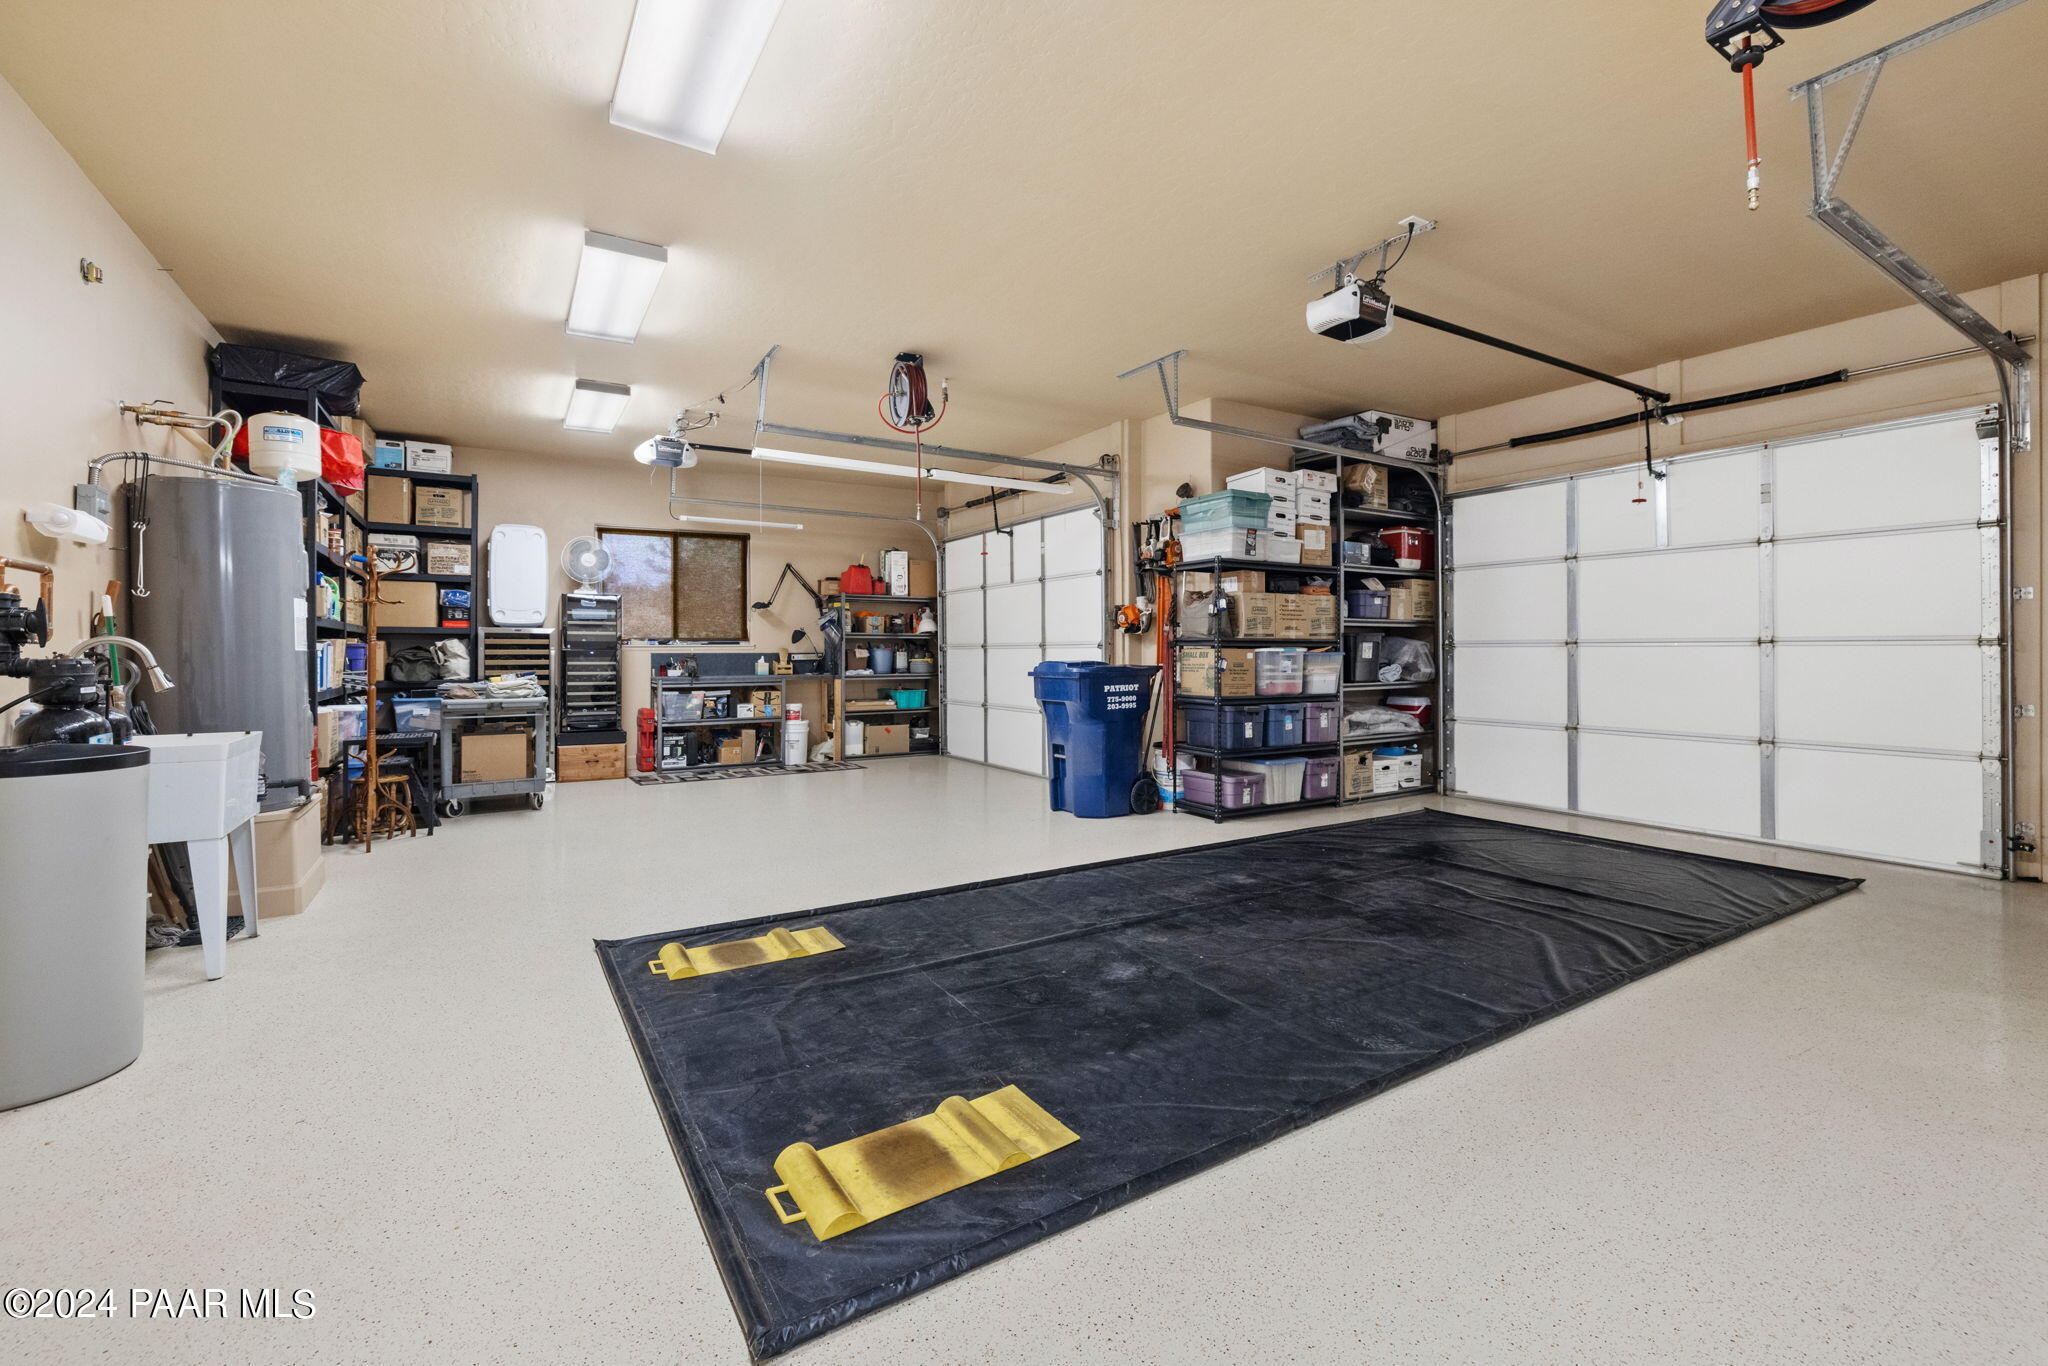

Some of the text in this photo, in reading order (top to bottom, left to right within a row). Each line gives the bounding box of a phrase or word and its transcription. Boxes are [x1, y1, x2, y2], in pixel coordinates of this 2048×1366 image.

[1410, 446, 1427, 454] CLUB
[1405, 450, 1426, 459] GLOVE
[1103, 684, 1139, 692] PATRIOT
